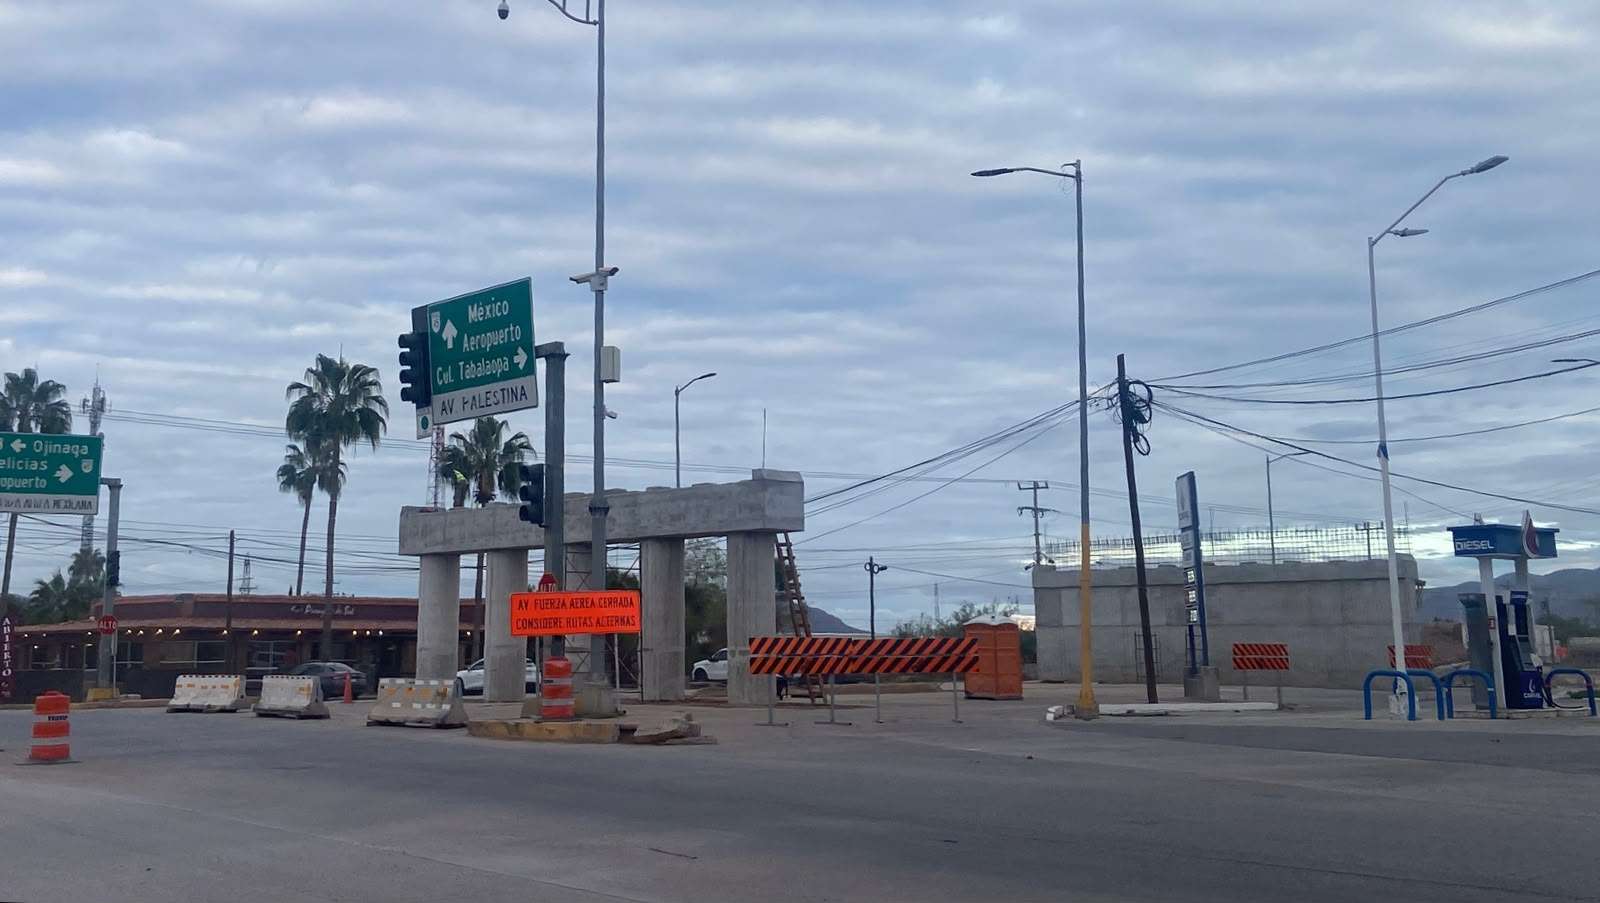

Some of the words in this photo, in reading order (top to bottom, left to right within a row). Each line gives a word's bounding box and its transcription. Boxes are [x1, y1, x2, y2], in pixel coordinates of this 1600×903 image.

[468, 297, 509, 323] México
[462, 323, 521, 352] Aeropuerto
[459, 356, 509, 380] Tabalaopa
[440, 398, 455, 417] AV
[33, 440, 89, 458] Ojinaga
[1455, 540, 1494, 550] DIESEL
[518, 599, 529, 611] AV
[534, 598, 567, 610] FUERZA
[569, 597, 596, 609] AEREA
[598, 596, 635, 608] CERRADA
[100, 620, 117, 630] ALTO
[515, 617, 562, 630] CONSIDERE
[566, 616, 593, 628] RUTAS
[595, 615, 636, 628] ALTERNAS
[2, 617, 12, 677] ABIERTO
